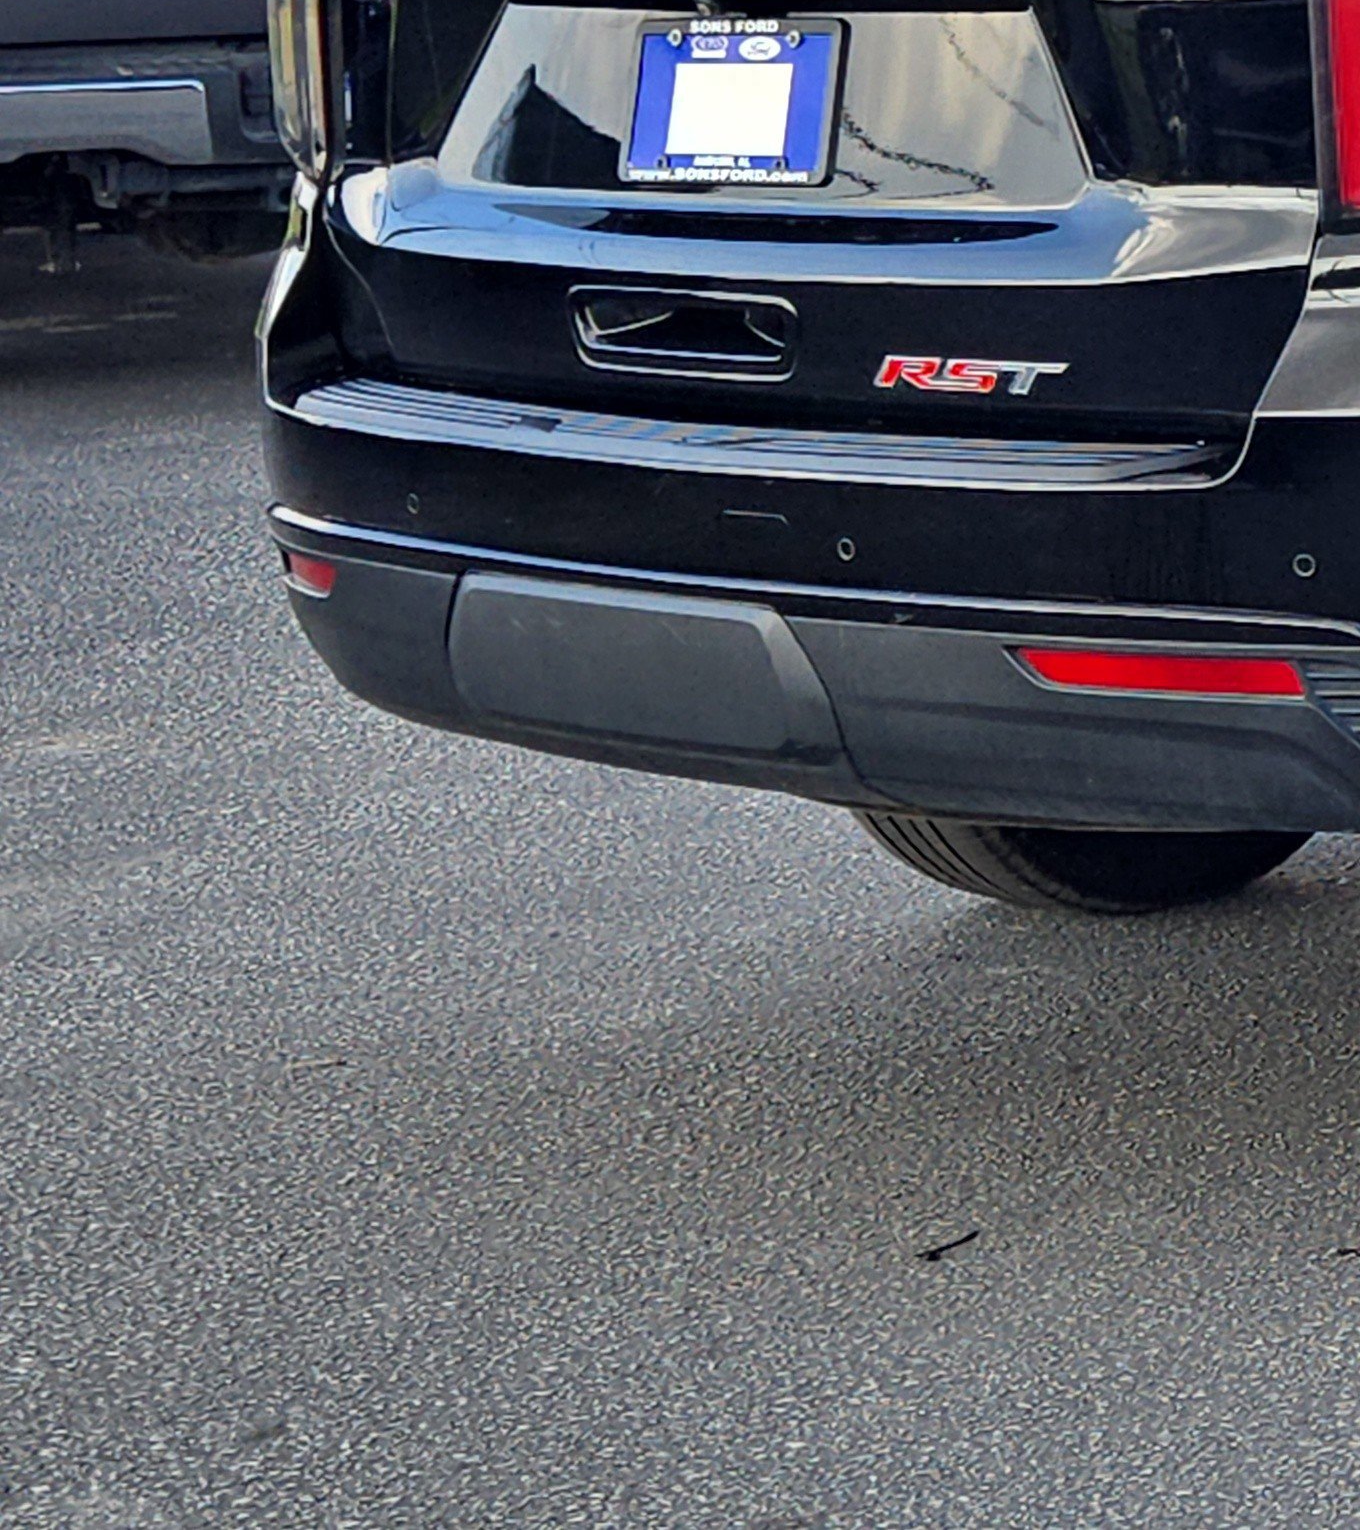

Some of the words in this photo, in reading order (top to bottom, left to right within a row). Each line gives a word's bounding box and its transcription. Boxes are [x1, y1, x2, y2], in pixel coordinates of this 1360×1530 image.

[690, 20, 732, 34] SONS
[735, 20, 779, 33] FORD
[873, 354, 1070, 396] RST
